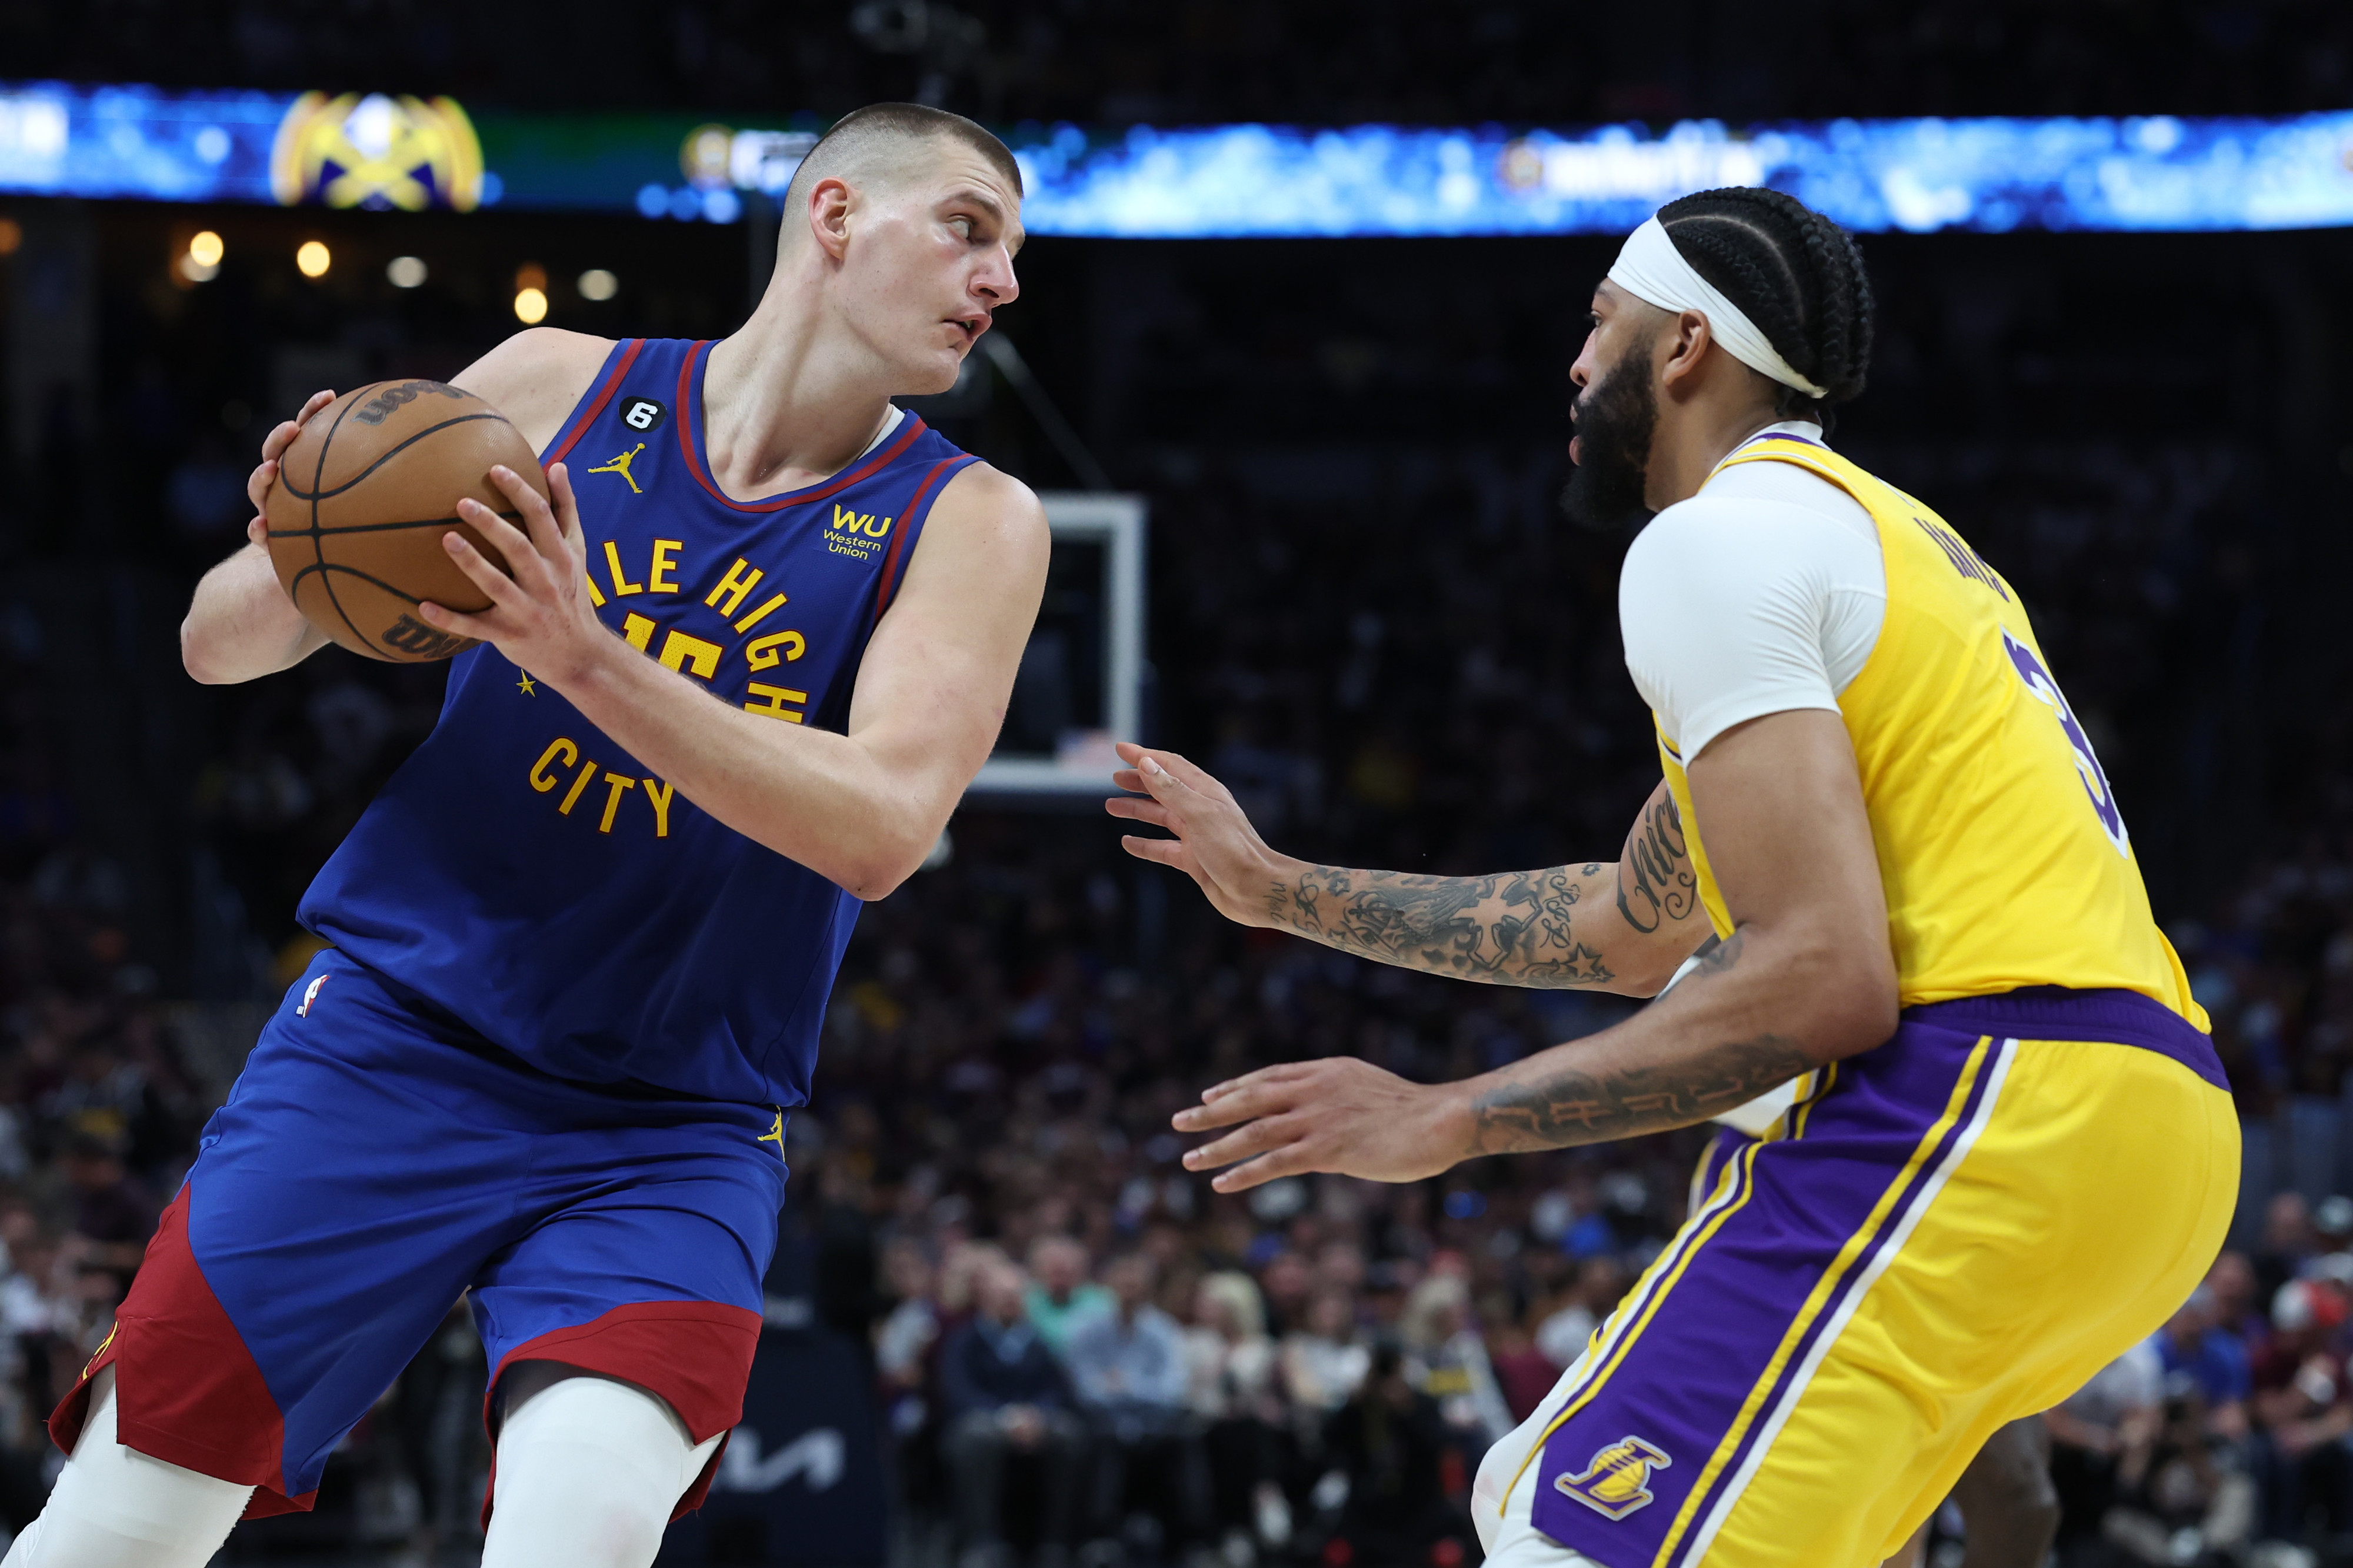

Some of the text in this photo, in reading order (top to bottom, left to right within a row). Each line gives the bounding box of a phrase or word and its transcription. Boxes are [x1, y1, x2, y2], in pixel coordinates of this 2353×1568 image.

[626, 402, 658, 429] 6
[833, 503, 892, 538] WU
[824, 529, 882, 552] Western
[828, 542, 869, 561] Union
[586, 538, 685, 609] ILE
[703, 555, 809, 724] HIGH
[1999, 621, 2129, 860] 3
[528, 736, 674, 839] CITY
